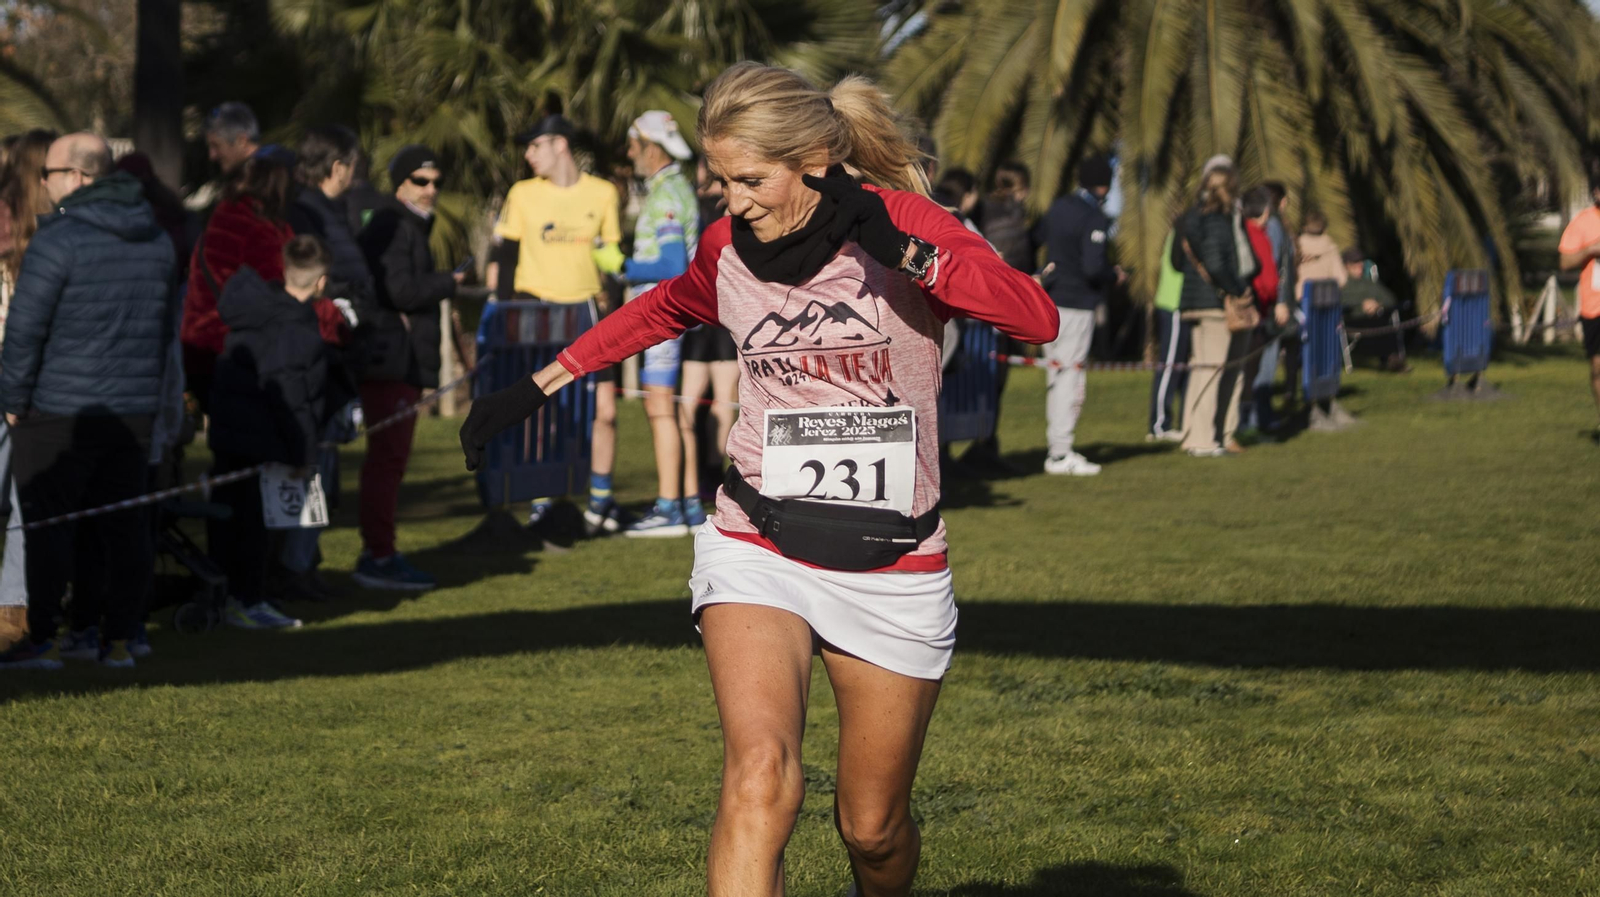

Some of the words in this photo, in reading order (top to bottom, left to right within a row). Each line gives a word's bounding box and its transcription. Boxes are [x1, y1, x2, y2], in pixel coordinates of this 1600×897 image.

[800, 354, 832, 384] LA
[779, 373, 807, 386] 2024
[799, 416, 847, 429] Reyes
[853, 415, 908, 429] Magos
[801, 427, 837, 437] Jerez
[842, 426, 876, 436] 2025
[799, 458, 890, 501] 231
